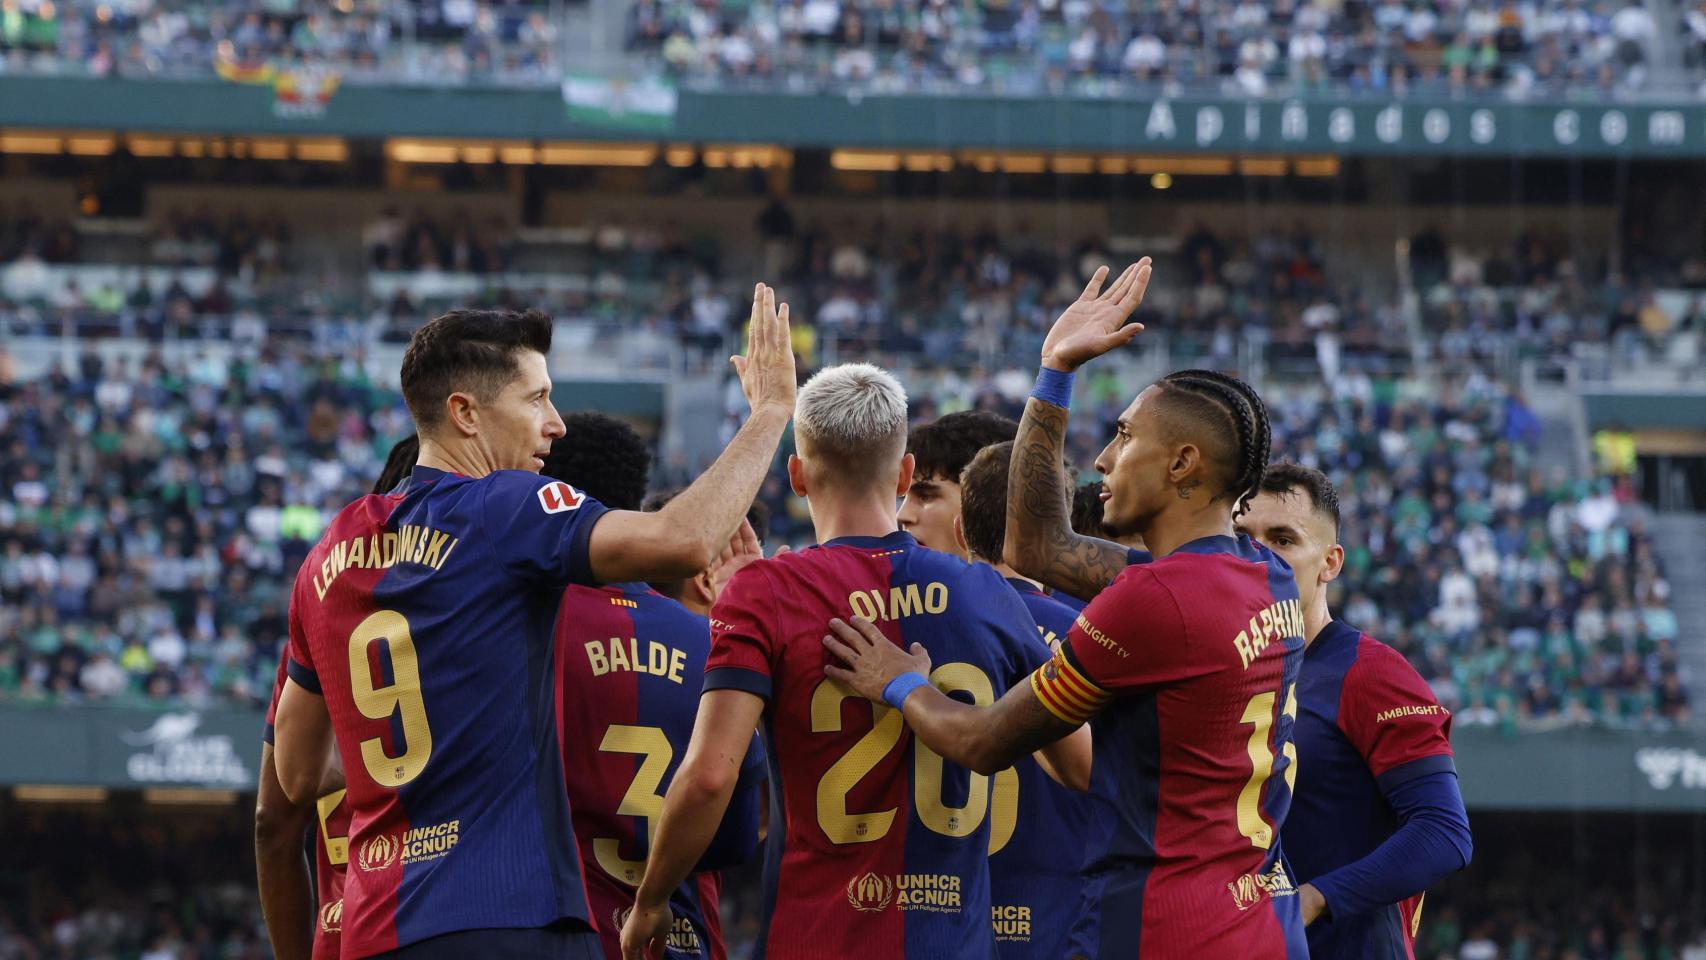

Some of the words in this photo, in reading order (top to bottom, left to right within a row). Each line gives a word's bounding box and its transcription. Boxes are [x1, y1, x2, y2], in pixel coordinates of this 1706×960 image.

[1145, 100, 1497, 147] Apiñados
[313, 525, 459, 602] LEWANDWSKI
[584, 637, 688, 685] BALDE
[349, 610, 433, 788] 9
[1376, 705, 1438, 723] AMBILIGHT
[811, 662, 995, 845] 20
[593, 724, 674, 887] 3
[403, 820, 460, 845] UNHCR
[400, 834, 459, 859] ACNUR
[896, 875, 961, 891] UNHCR
[896, 890, 961, 906] ACNUR
[991, 905, 1031, 921] HCR
[992, 920, 1031, 935] NUR
